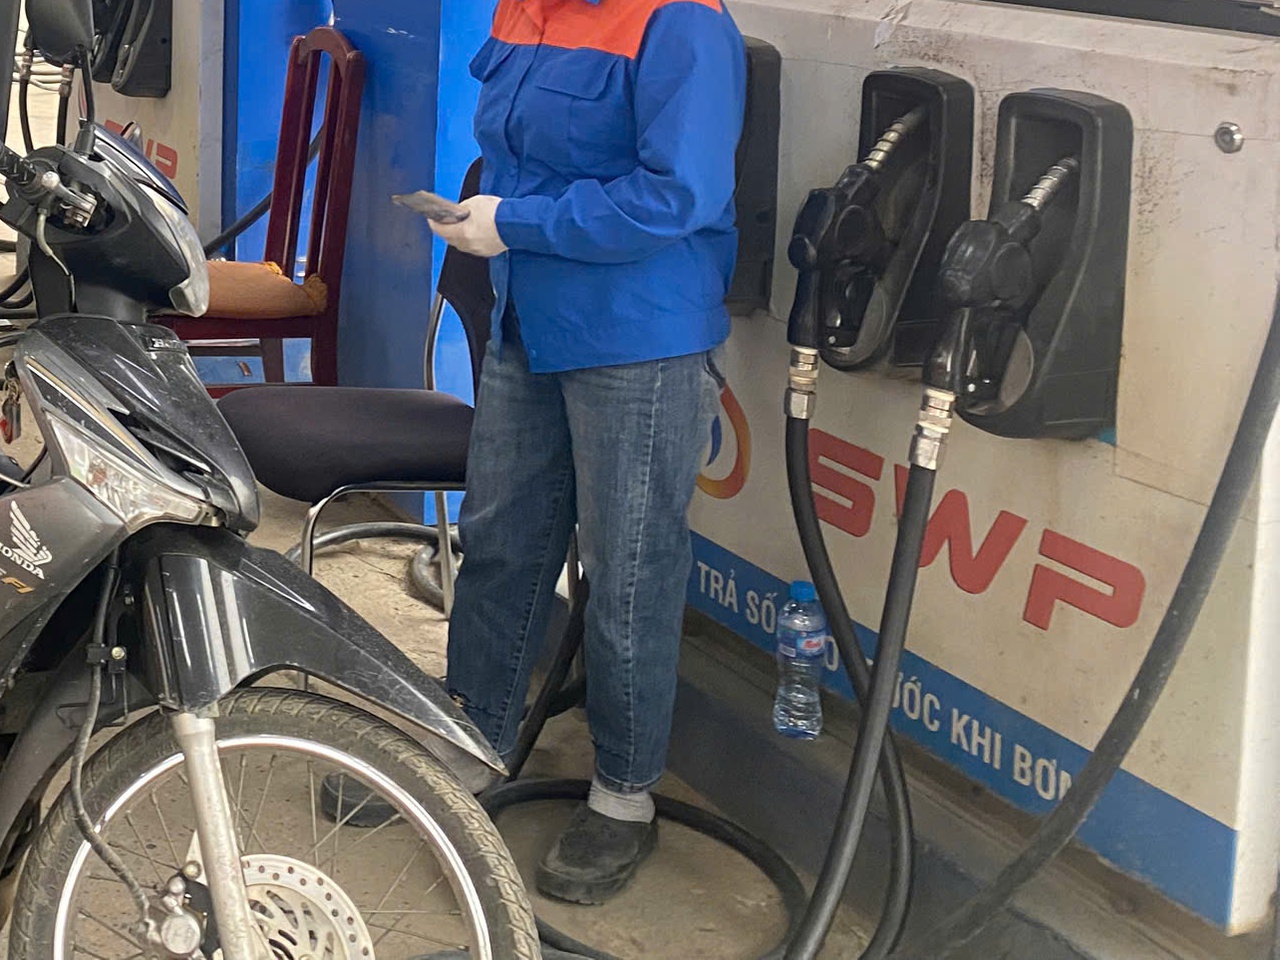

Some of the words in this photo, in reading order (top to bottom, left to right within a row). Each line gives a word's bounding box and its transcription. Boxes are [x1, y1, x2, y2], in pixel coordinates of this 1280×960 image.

[806, 427, 1147, 631] SWP
[697, 560, 739, 613] TRẢ
[745, 589, 778, 634] SỐ
[950, 707, 1002, 770] KHI
